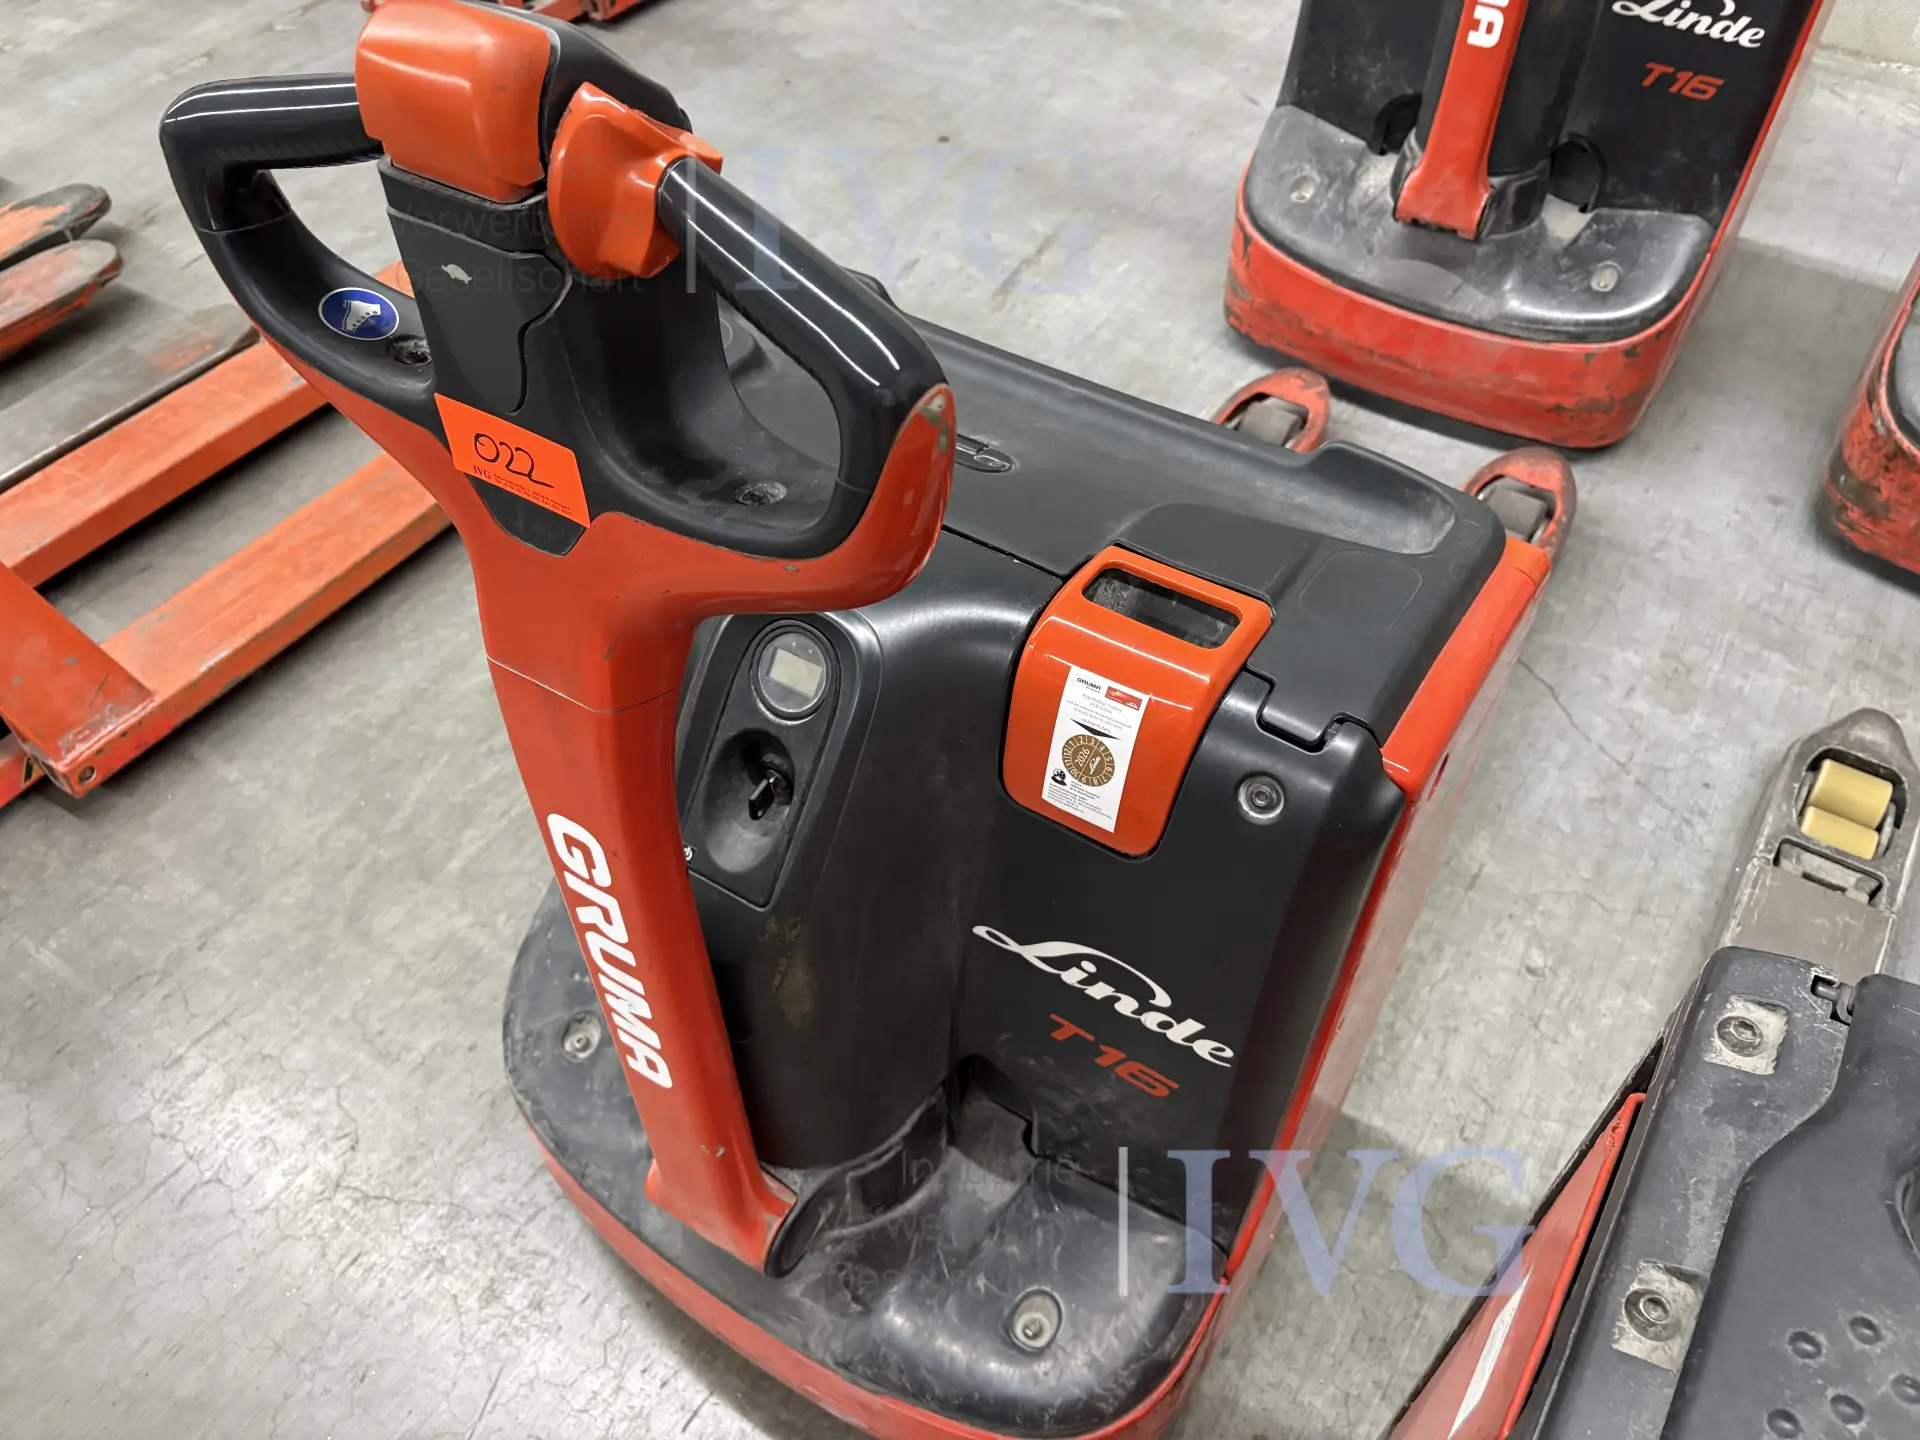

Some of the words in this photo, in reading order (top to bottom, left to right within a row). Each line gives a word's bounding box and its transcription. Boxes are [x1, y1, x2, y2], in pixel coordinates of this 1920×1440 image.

[1611, 0, 1765, 48] Linde
[1641, 62, 1725, 101] T16
[474, 432, 555, 489] 022
[1074, 747, 1090, 767] 2026
[547, 813, 673, 1088] GRUMA
[972, 925, 1234, 1067] Linde
